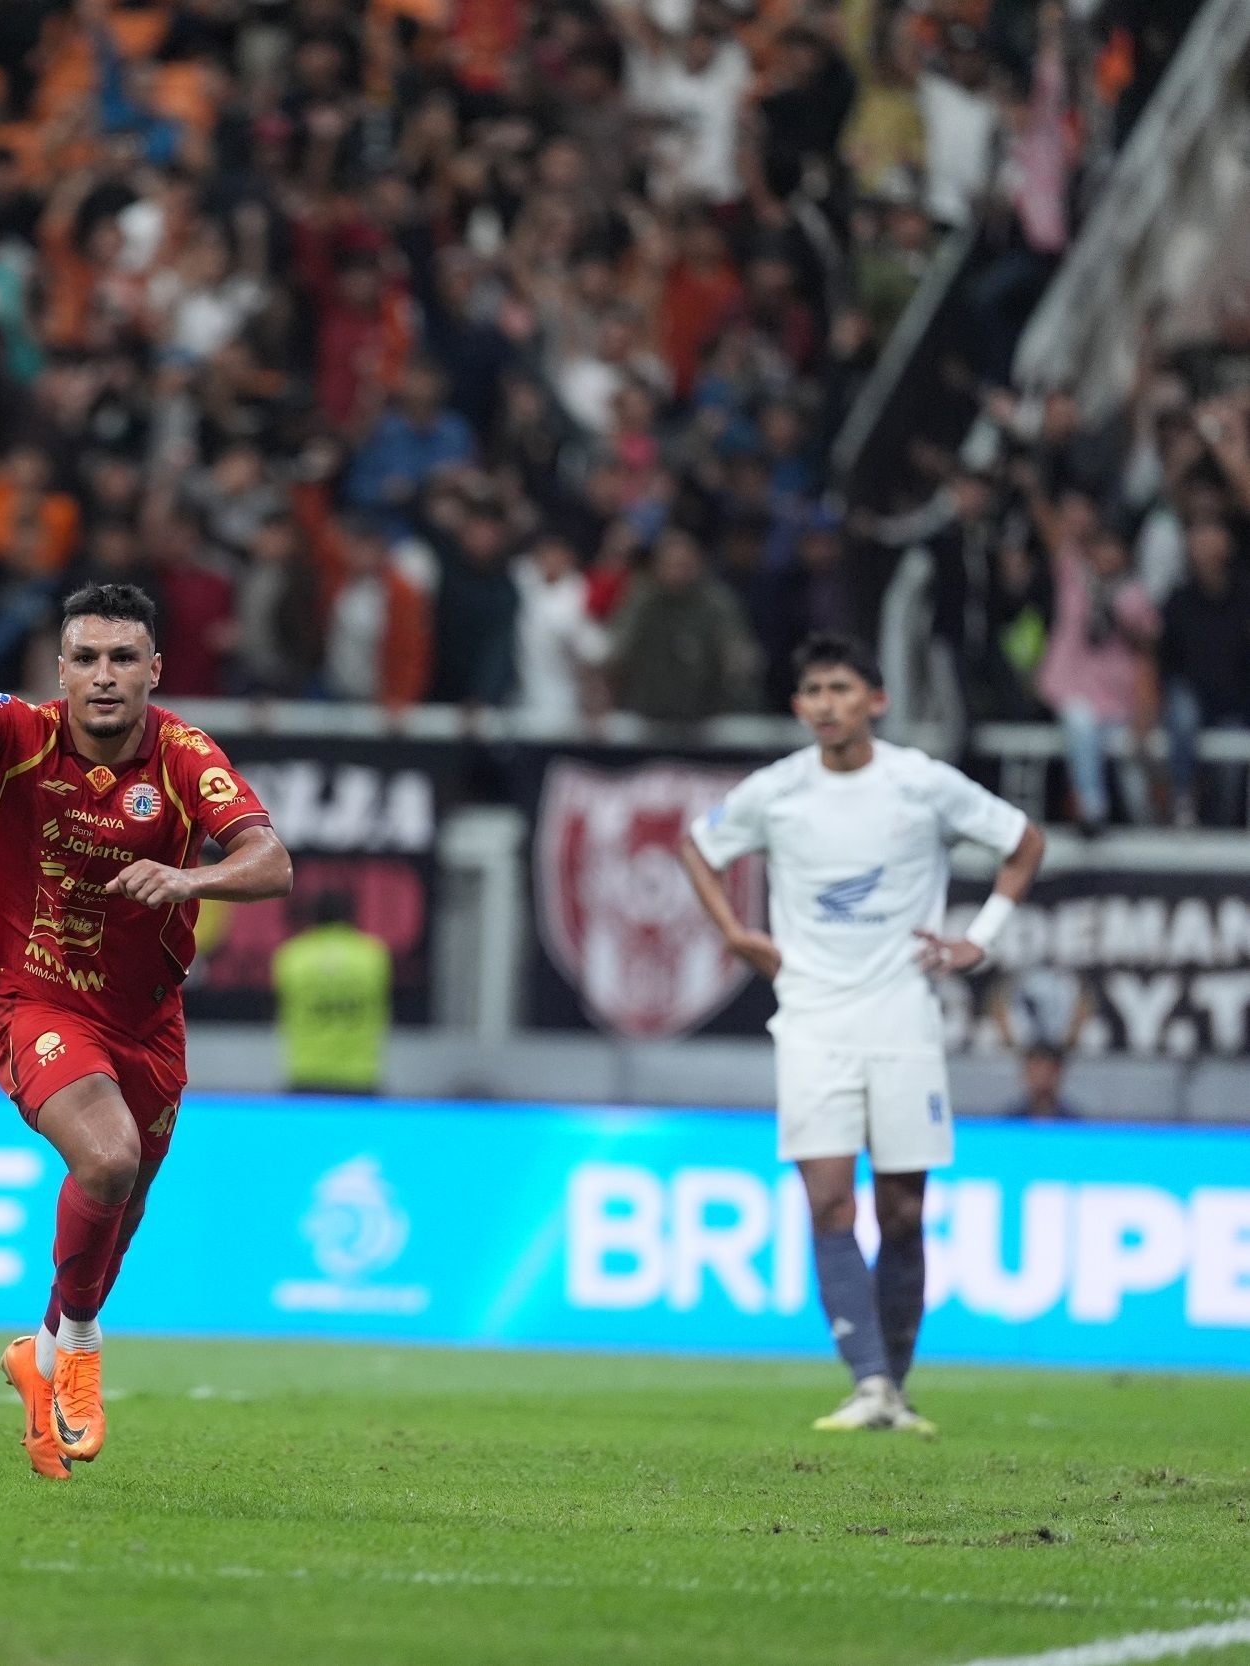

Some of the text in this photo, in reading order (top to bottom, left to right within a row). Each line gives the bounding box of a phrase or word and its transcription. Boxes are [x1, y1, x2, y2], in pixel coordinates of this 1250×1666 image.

[71, 824, 95, 838] Bank
[61, 835, 134, 863] Jakarta
[23, 961, 65, 985] AMMAN
[38, 1044, 67, 1067] TCT
[566, 1161, 811, 1316] BRI
